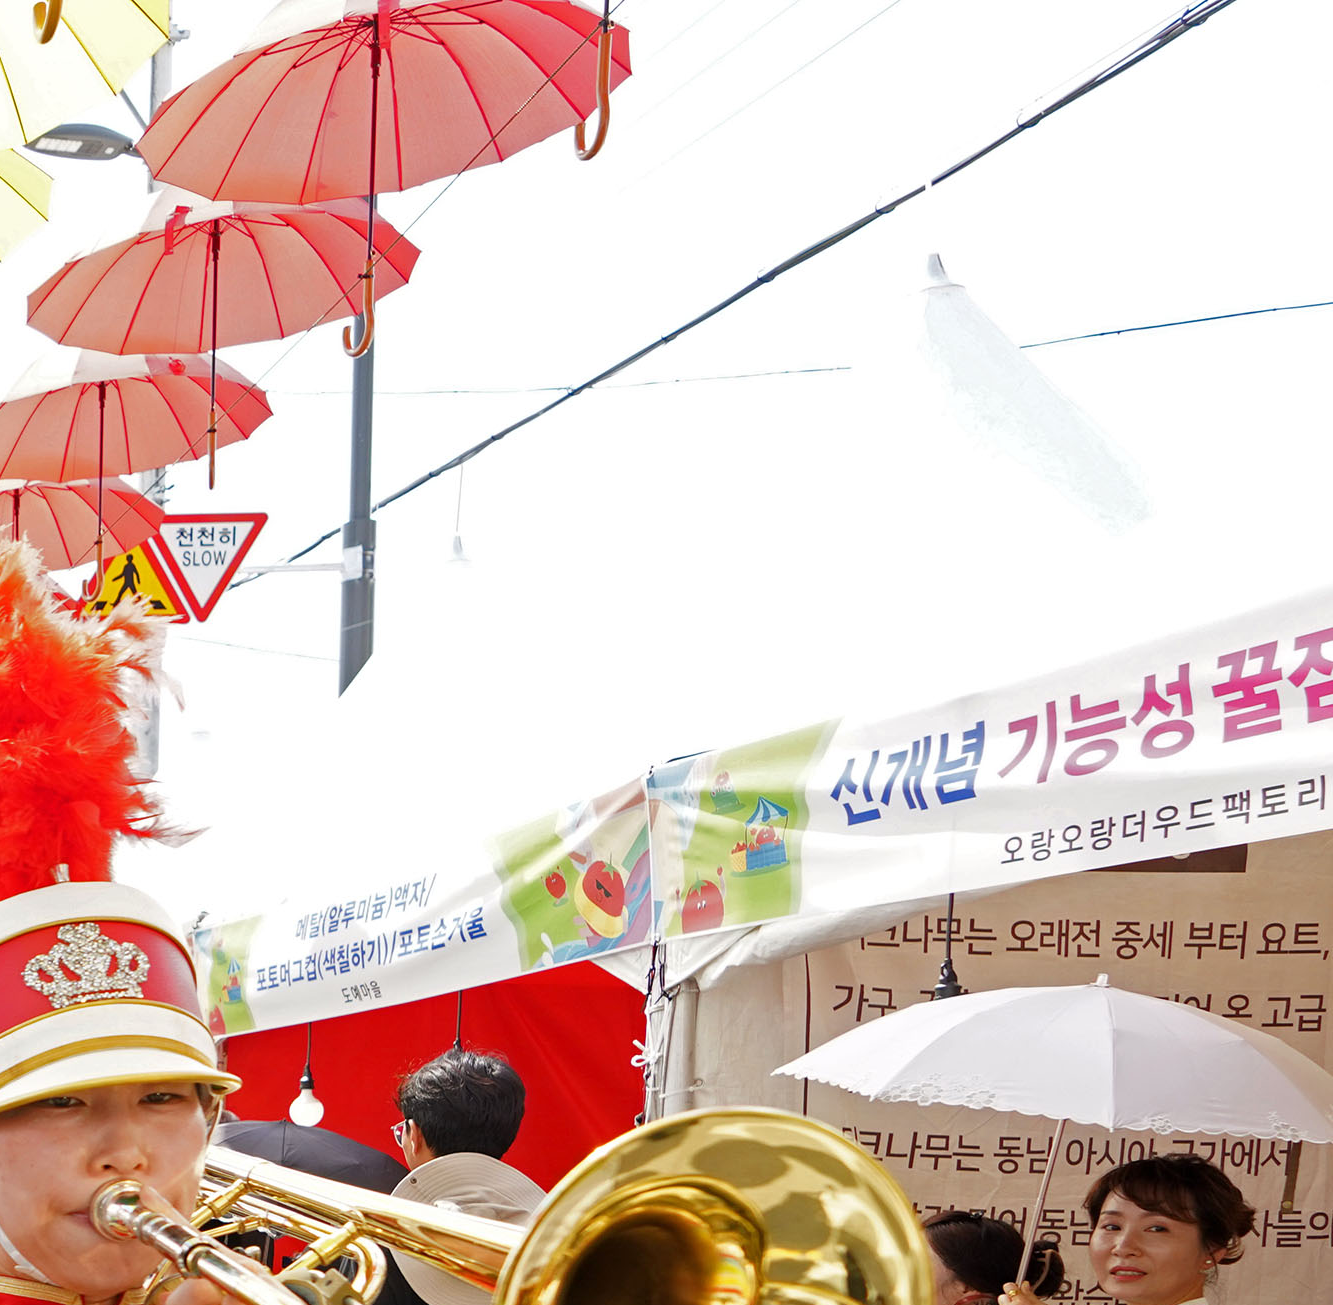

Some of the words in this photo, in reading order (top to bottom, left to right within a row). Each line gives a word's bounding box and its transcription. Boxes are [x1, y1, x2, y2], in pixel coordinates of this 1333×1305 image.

[175, 525, 237, 548] 천천히
[182, 551, 227, 566] SLOW
[830, 720, 986, 826] 신개념
[997, 662, 1195, 784] 기능성
[1000, 774, 1328, 866] 오랑오랑더우드팩토리
[295, 873, 437, 941] 메탈(알루미늄)액자/
[256, 906, 488, 992] 포토머그컵(색칠하기)/포토손거울
[1006, 919, 1101, 957] 오래전
[1111, 920, 1174, 960] 중세
[1184, 920, 1248, 960] 부터
[1256, 922, 1329, 961] 요트,
[341, 980, 382, 1004] 도예마을
[1222, 994, 1252, 1018] 오
[1261, 994, 1327, 1032] 고급
[993, 1136, 1054, 1174] 동남
